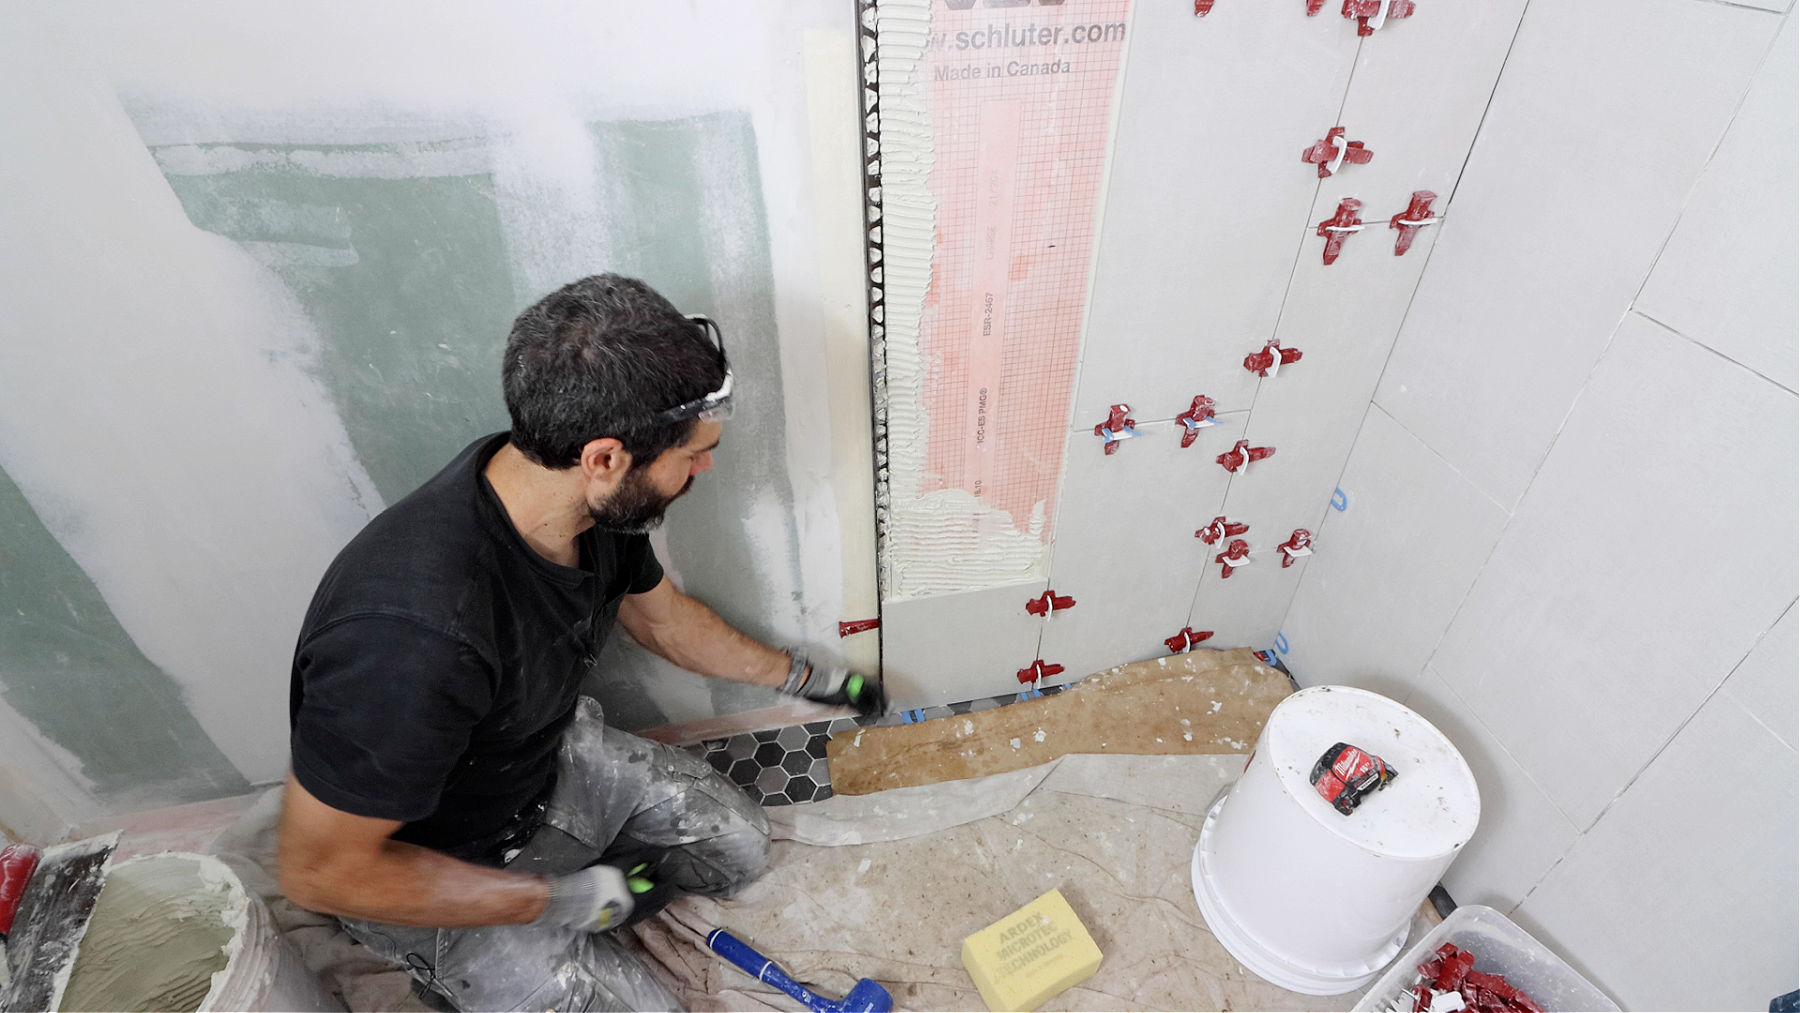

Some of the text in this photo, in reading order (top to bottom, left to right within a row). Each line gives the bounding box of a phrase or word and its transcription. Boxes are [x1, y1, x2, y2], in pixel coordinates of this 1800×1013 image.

[934, 59, 1071, 81] Made in Canada
[982, 292, 994, 336] ESR-2467
[996, 919, 1057, 961] MICROTEC
[999, 911, 1043, 943] ARDEX
